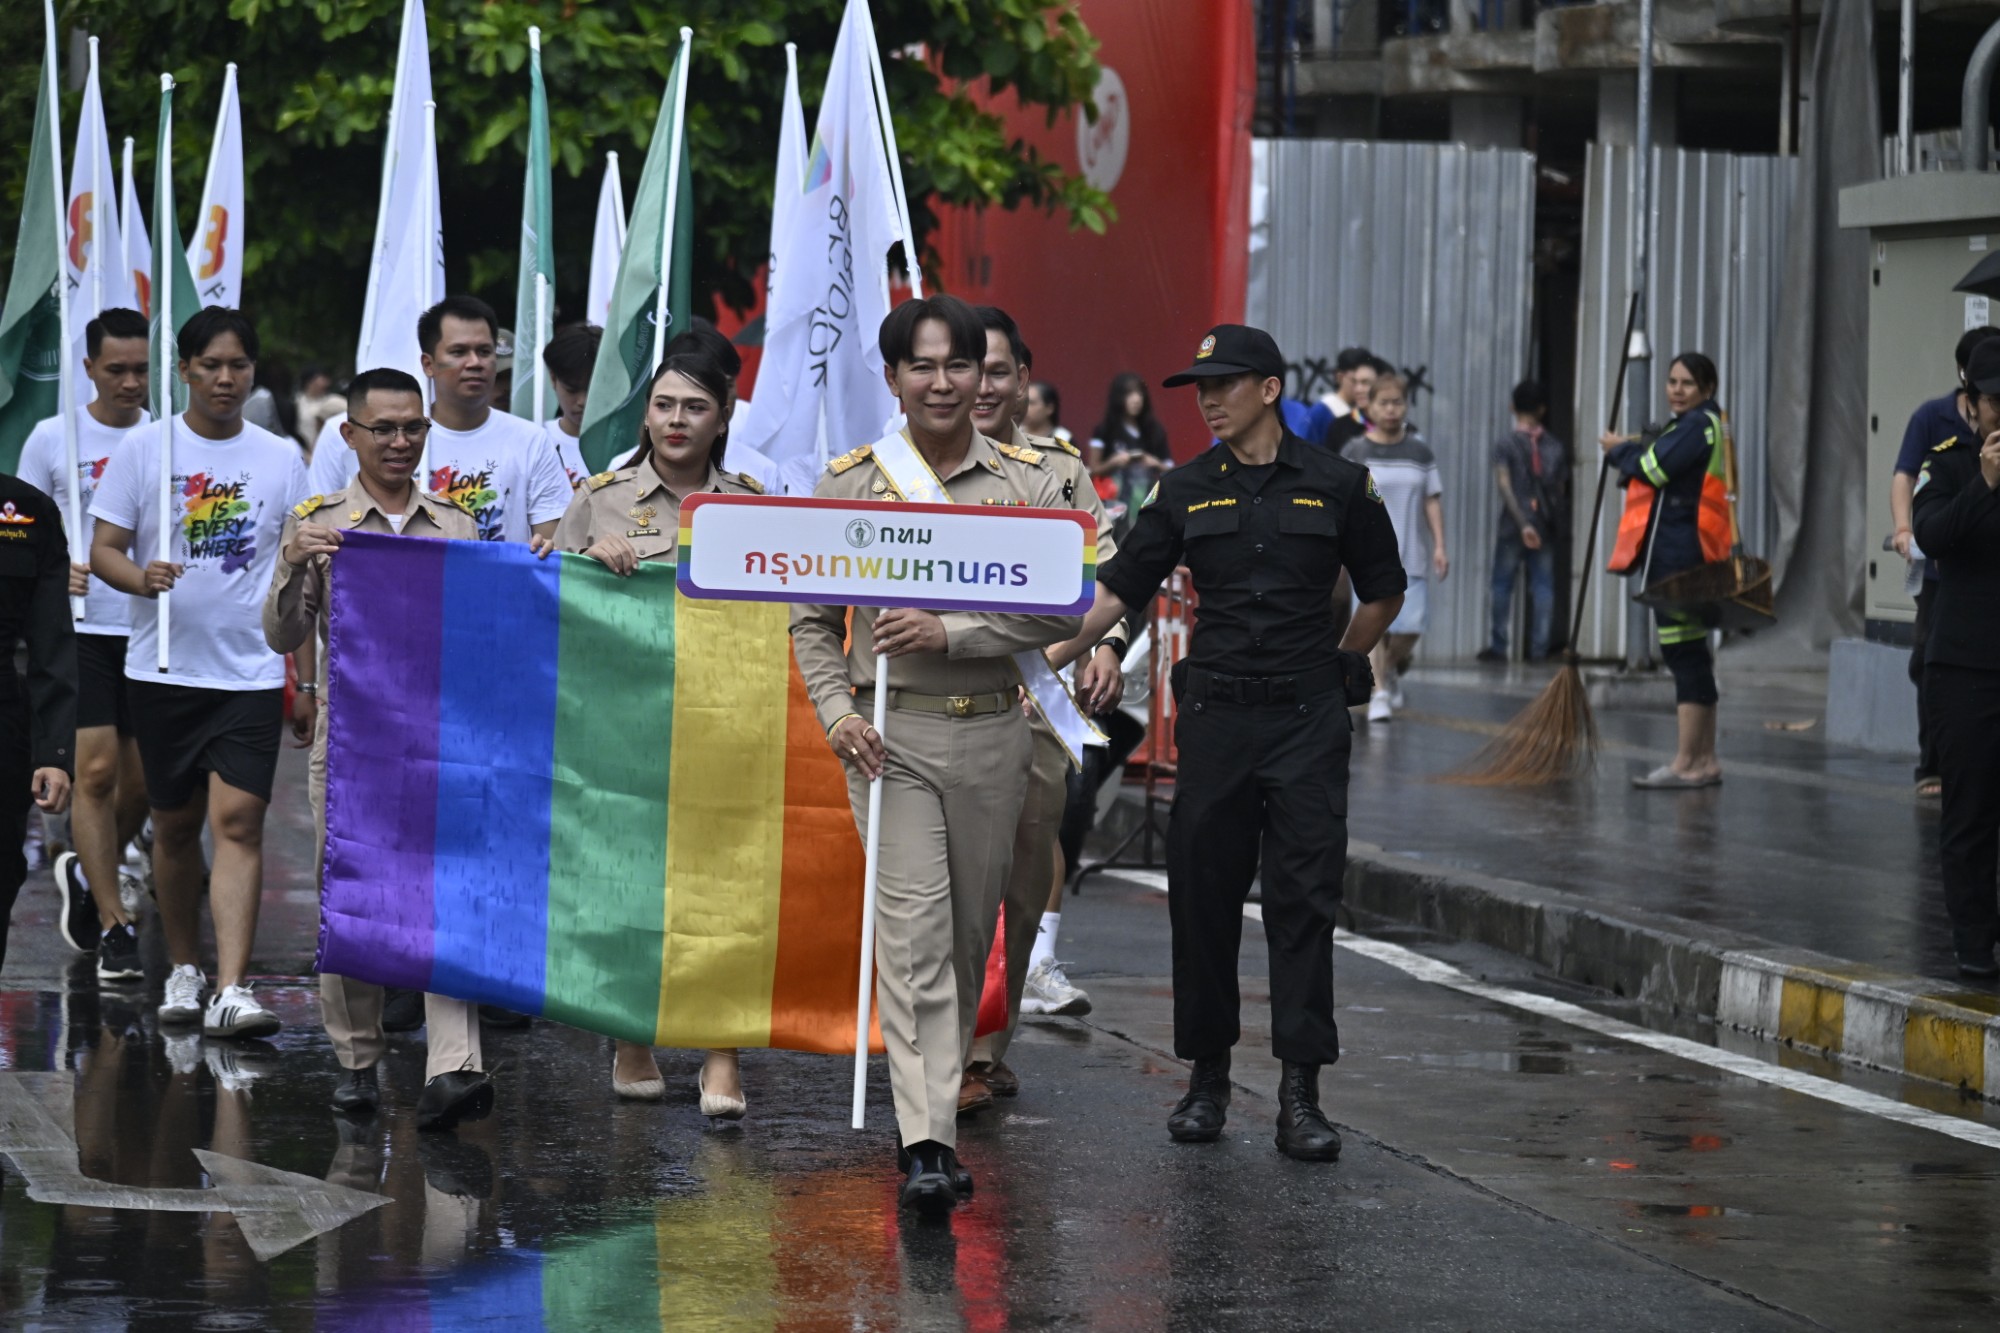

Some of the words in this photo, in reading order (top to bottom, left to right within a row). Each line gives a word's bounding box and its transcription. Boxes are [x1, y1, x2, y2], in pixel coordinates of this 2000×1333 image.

[201, 478, 248, 500] LOVE
[448, 470, 493, 493] LOVE
[210, 501, 230, 519] IS
[190, 517, 248, 539] EVERY
[880, 525, 933, 545] กทม
[190, 538, 250, 560] WHERE
[745, 550, 1029, 586] กรุงเทพมหานคร
